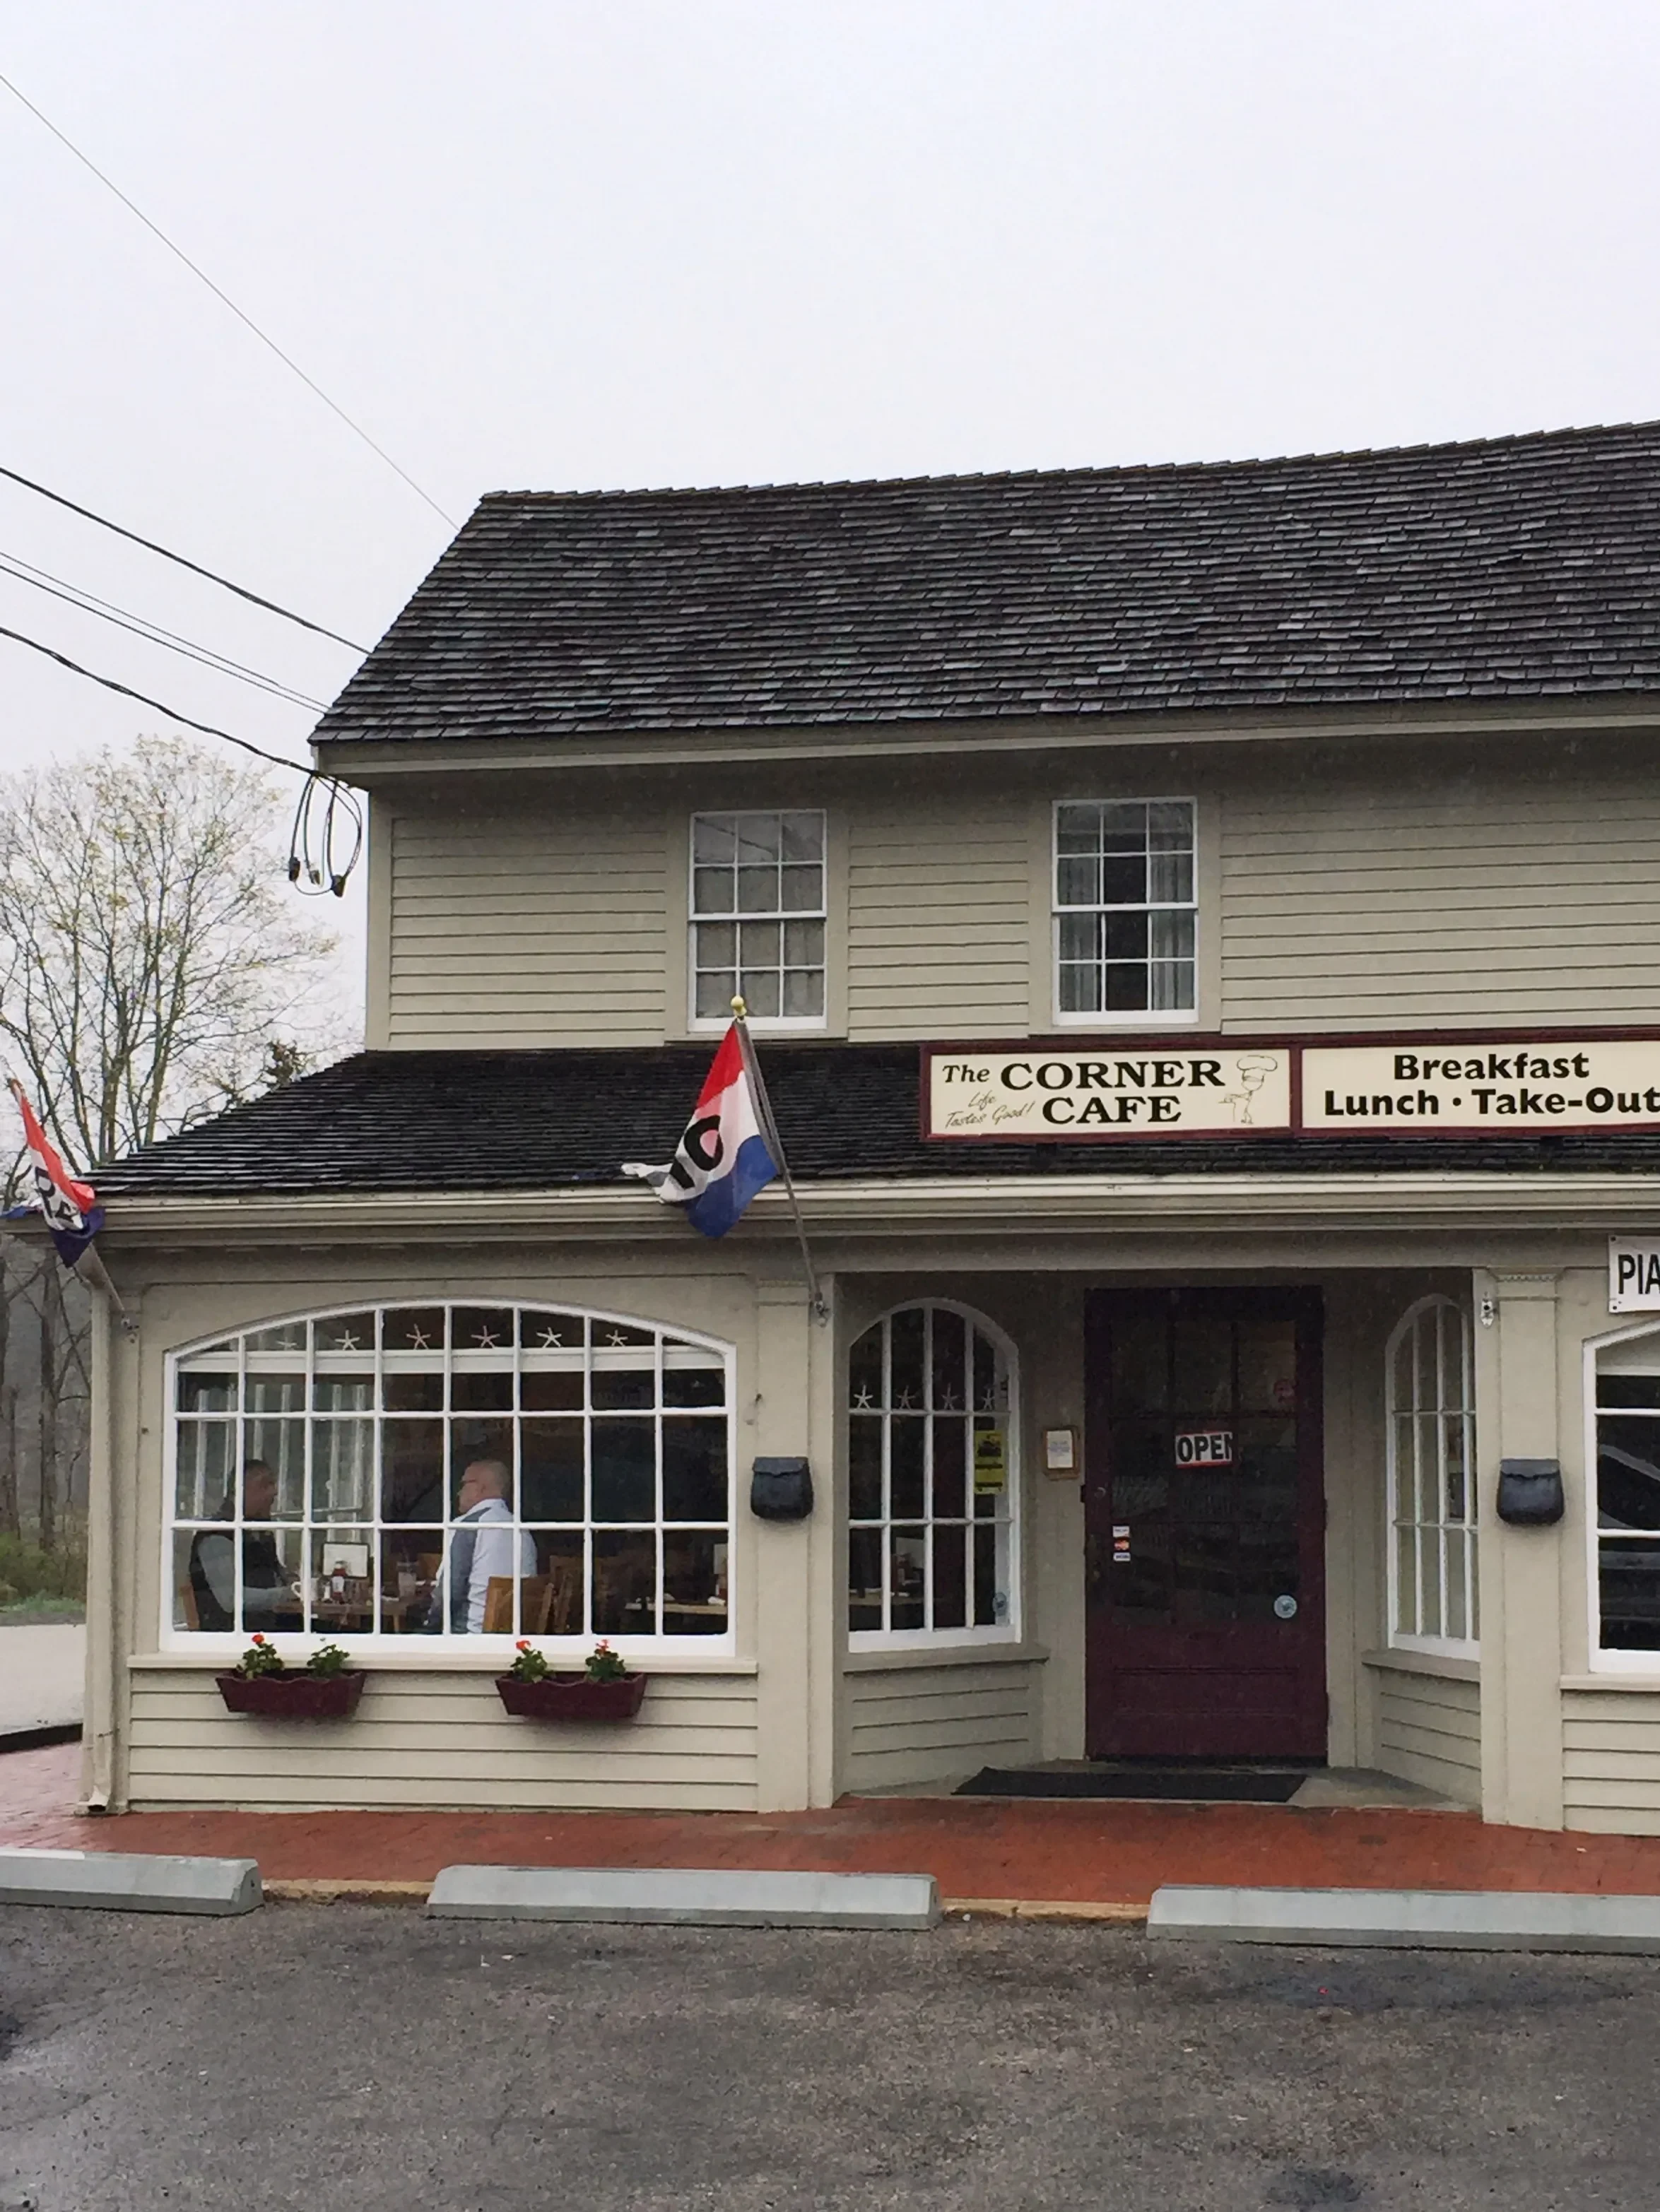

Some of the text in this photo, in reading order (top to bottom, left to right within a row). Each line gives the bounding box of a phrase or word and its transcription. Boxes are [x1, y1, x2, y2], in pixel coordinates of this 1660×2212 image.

[943, 1060, 1225, 1090] The CORNER
[1394, 1053, 1589, 1080] Breakfast
[967, 1089, 996, 1111] Life
[1043, 1096, 1181, 1124] CAFE
[1325, 1087, 1660, 1116] Lunch Take-Out
